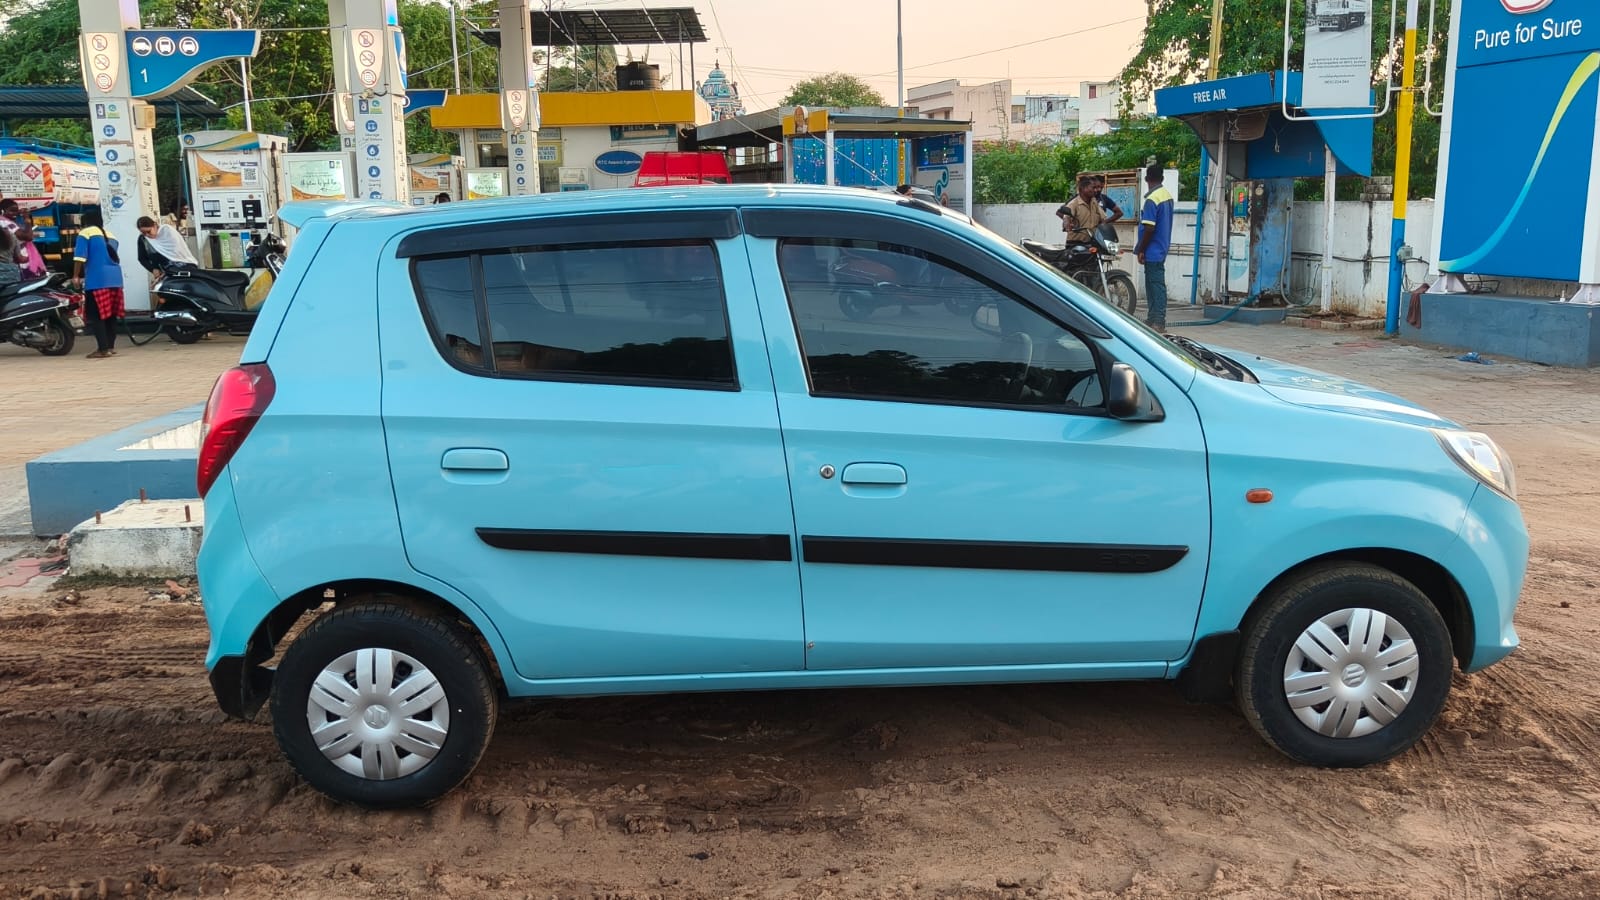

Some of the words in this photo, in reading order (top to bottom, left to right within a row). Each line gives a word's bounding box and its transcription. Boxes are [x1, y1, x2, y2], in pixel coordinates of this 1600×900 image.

[1474, 29, 1510, 50] Pure
[1515, 22, 1537, 44] for
[1541, 18, 1582, 40] Sure
[140, 67, 148, 83] 1
[1192, 90, 1211, 104] FREE
[1213, 88, 1227, 101] AIR
